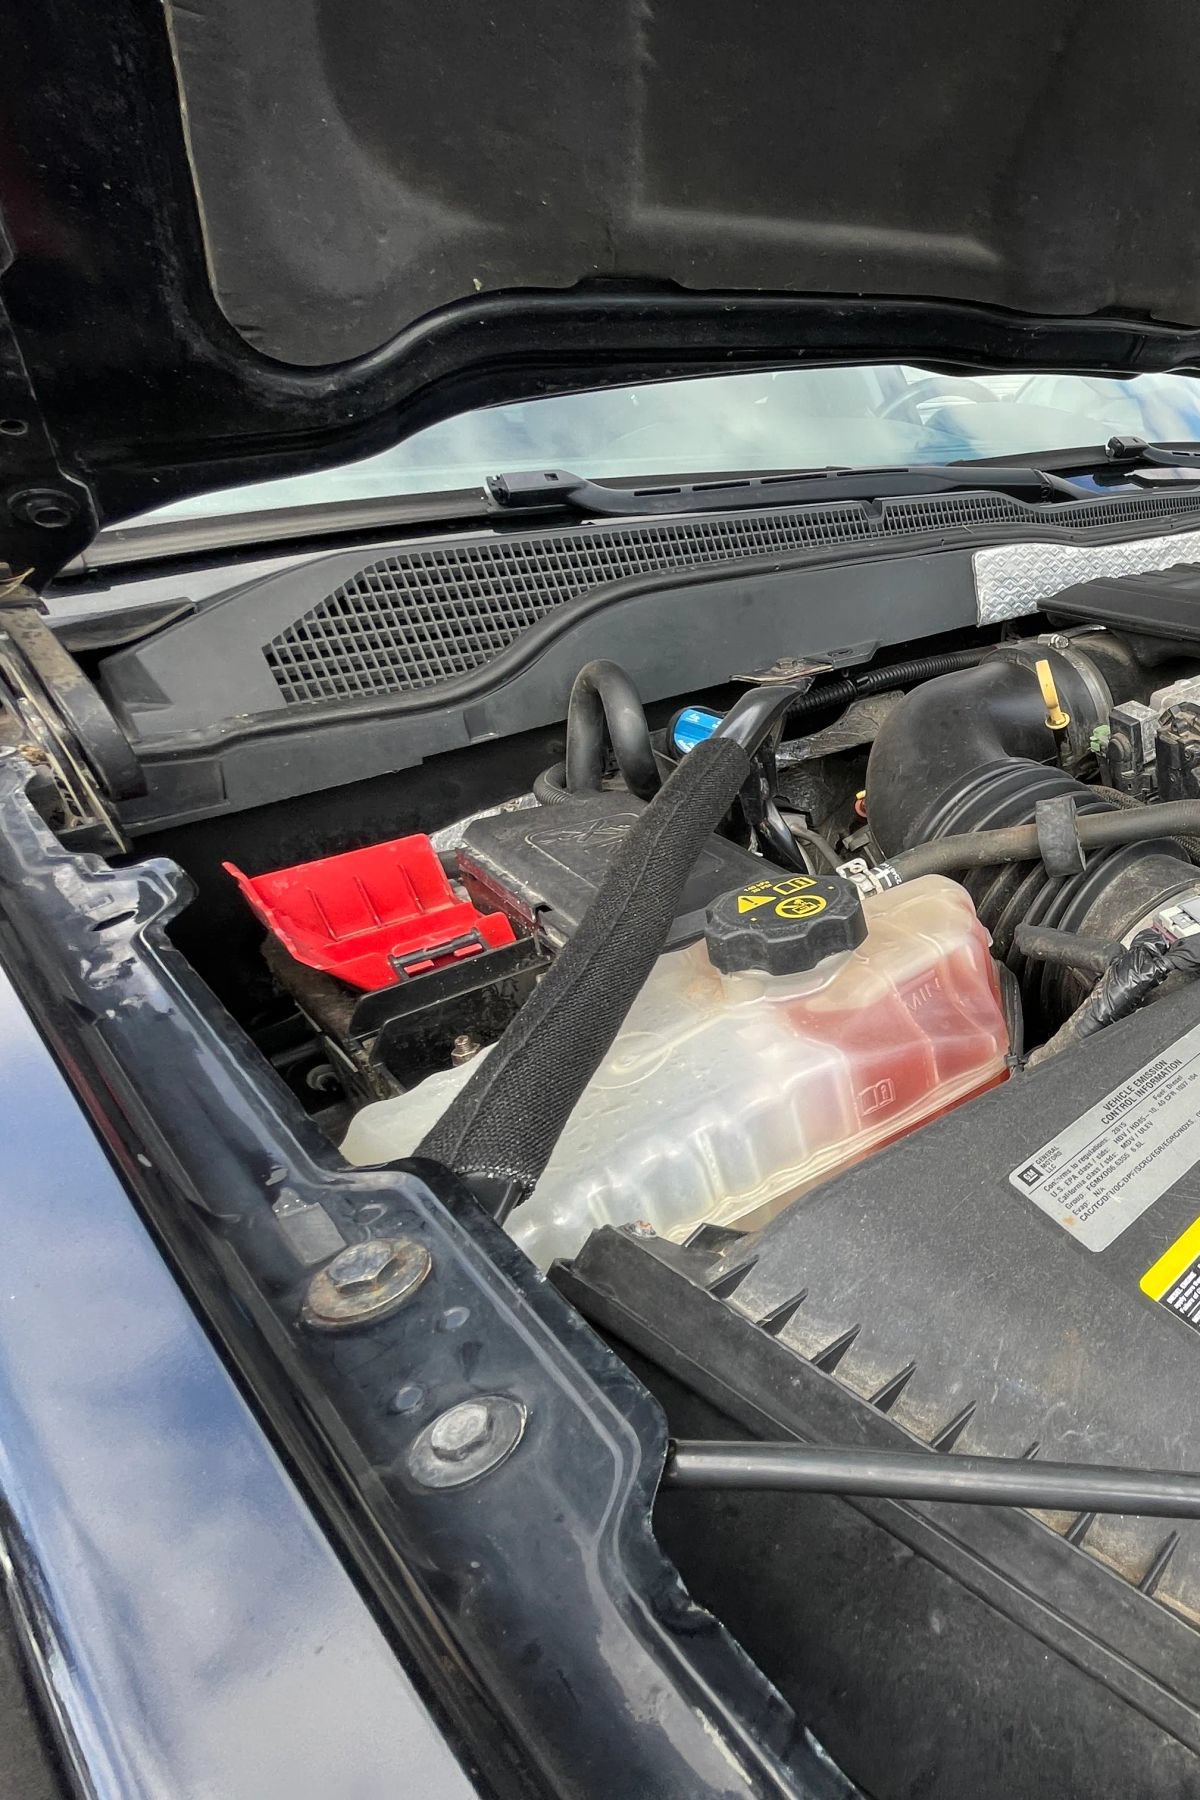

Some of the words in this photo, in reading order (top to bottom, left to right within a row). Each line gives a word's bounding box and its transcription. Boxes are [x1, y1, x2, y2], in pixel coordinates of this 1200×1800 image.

[1099, 1094, 1137, 1125] CONTROL
[1133, 1058, 1182, 1097] INFORMATION
[1102, 1085, 1135, 1111] VEHICLE
[1131, 1059, 1168, 1087] EMISSION
[1034, 1144, 1059, 1164] GENERAL
[1039, 1150, 1063, 1169] MOTORS
[1021, 1168, 1037, 1181] GM
